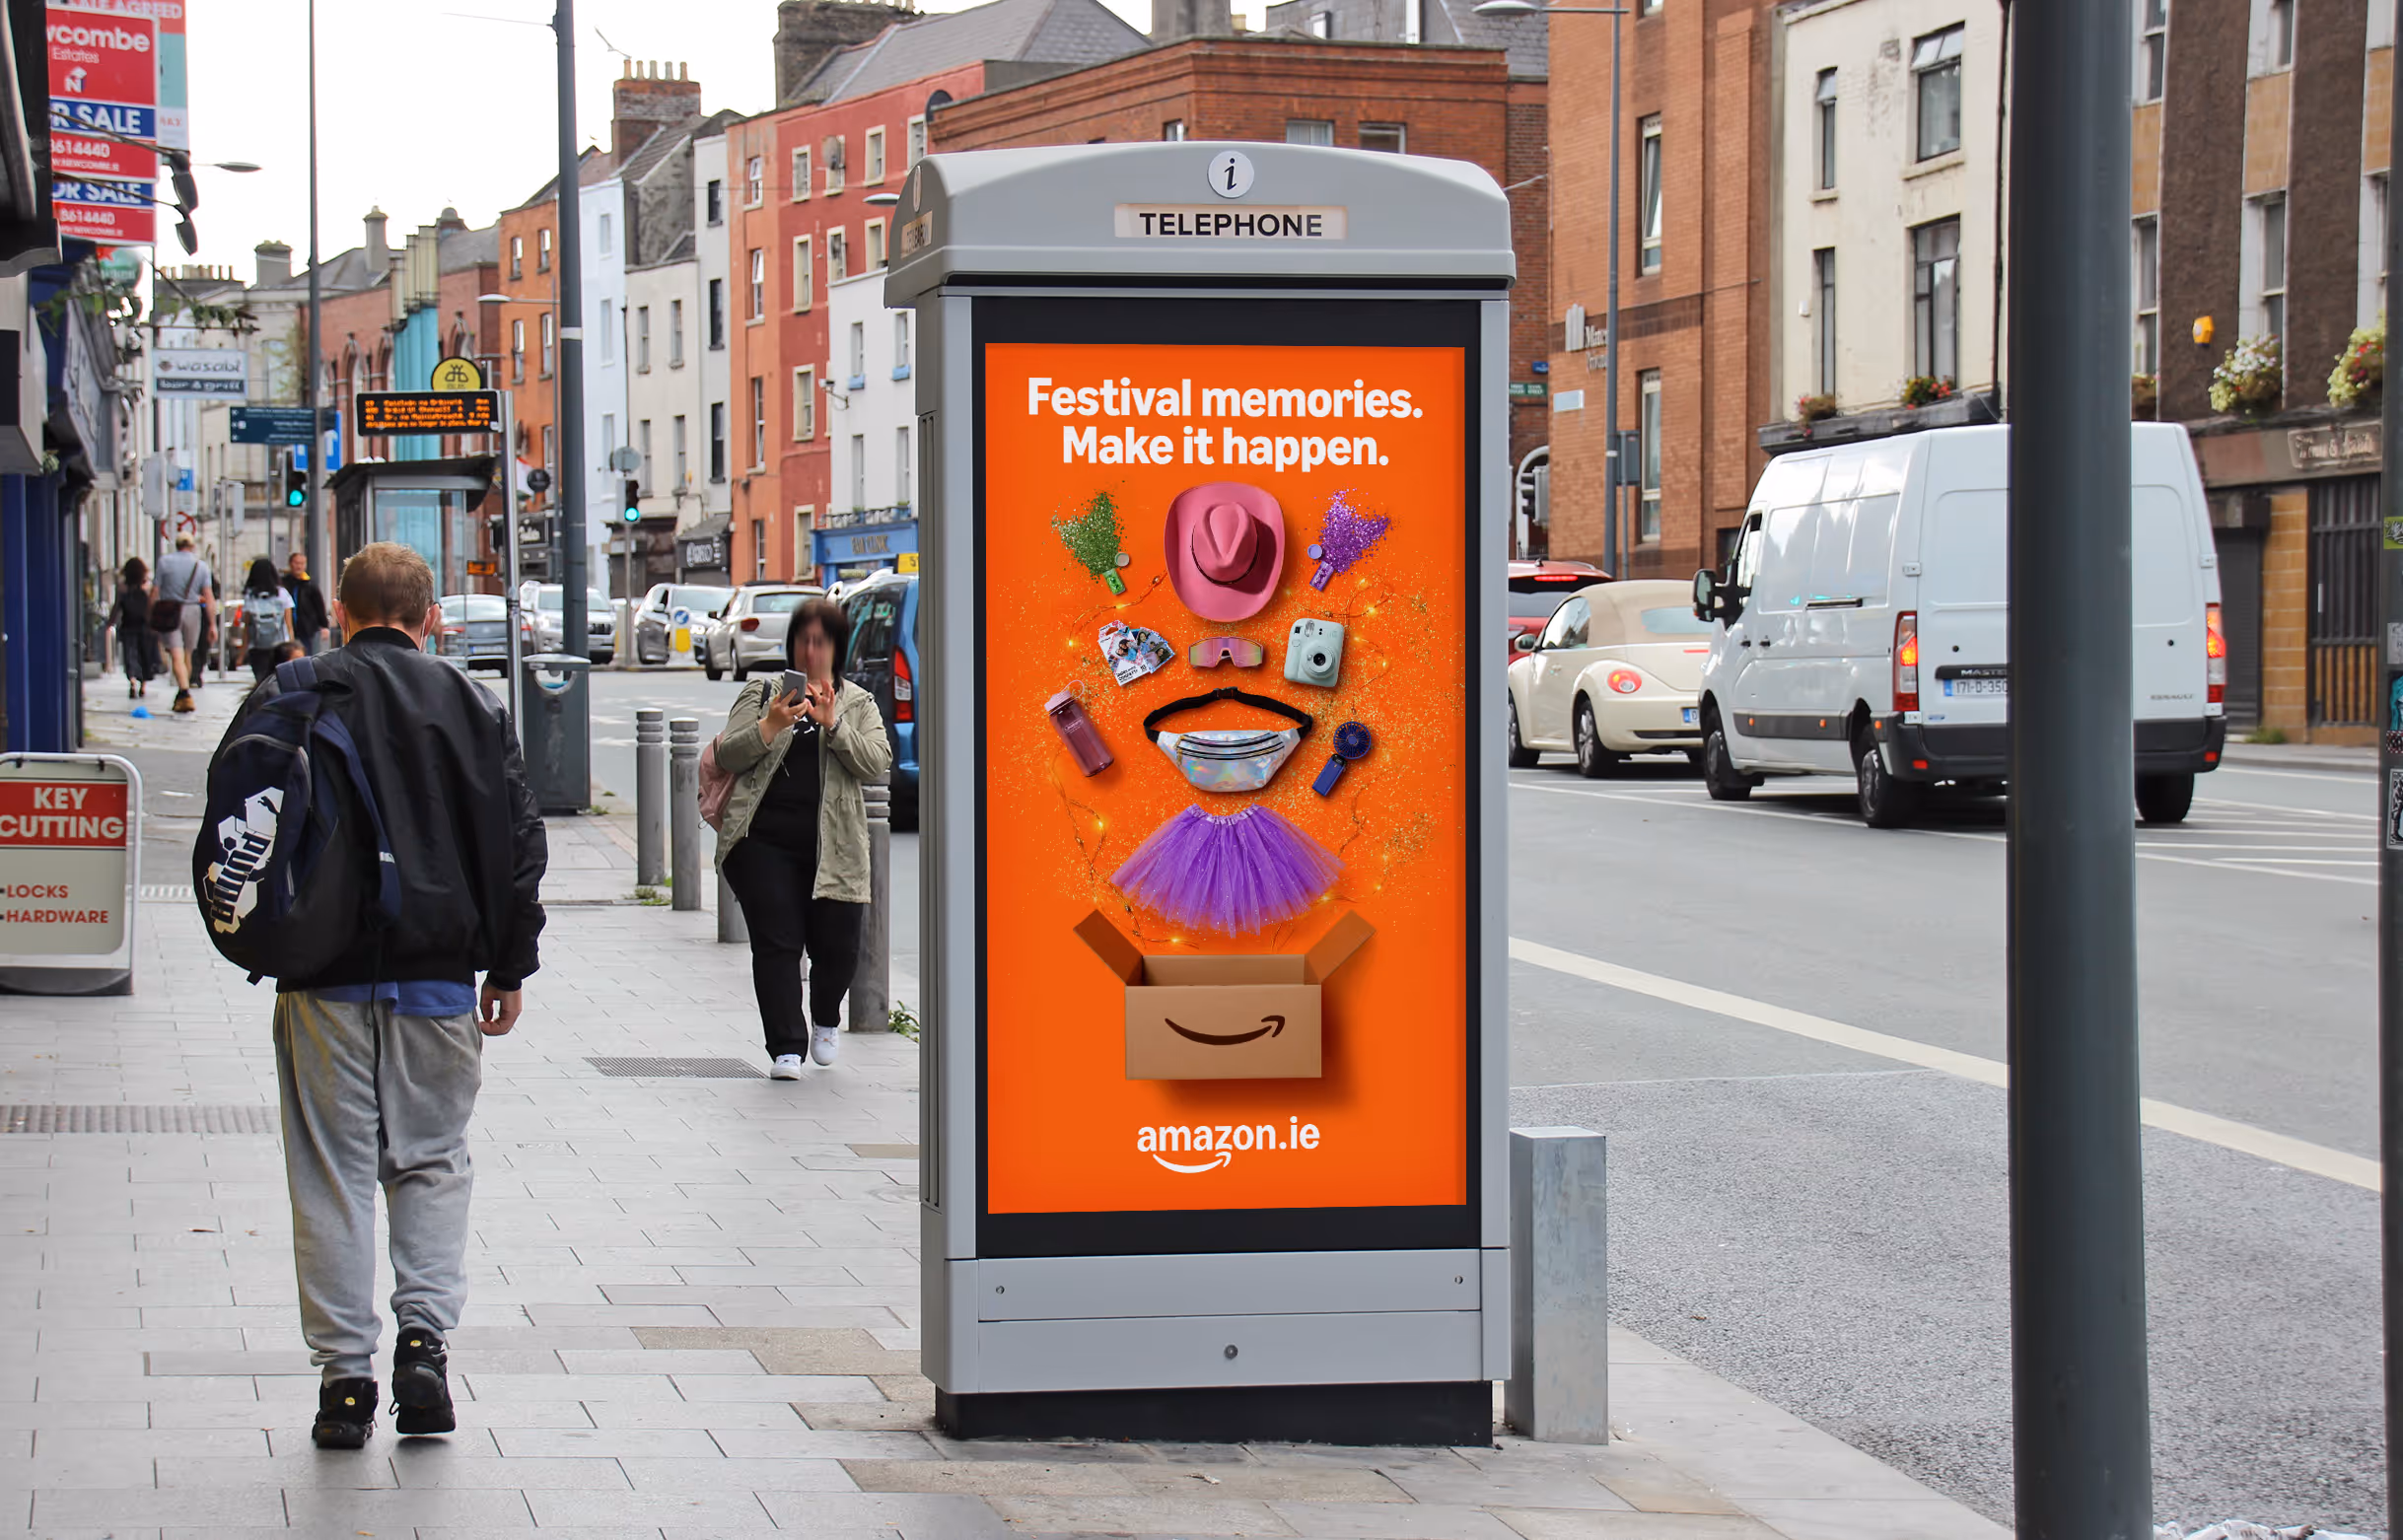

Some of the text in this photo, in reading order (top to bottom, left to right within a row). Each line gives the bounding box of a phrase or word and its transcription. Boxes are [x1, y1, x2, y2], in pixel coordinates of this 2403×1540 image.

[77, 105, 141, 134] SALE
[86, 183, 141, 204] SALE
[1139, 213, 1322, 237] TELEPHONE
[177, 358, 241, 373] wasabi
[1028, 378, 1423, 419] Festival memories.
[1062, 426, 1389, 472] Make it happen.
[34, 788, 89, 810] KEY
[0, 814, 124, 839] CUTTING
[7, 883, 69, 899] LOCKS
[6, 909, 108, 924] HARDWARE
[1137, 1116, 1320, 1152] amazon.ie
